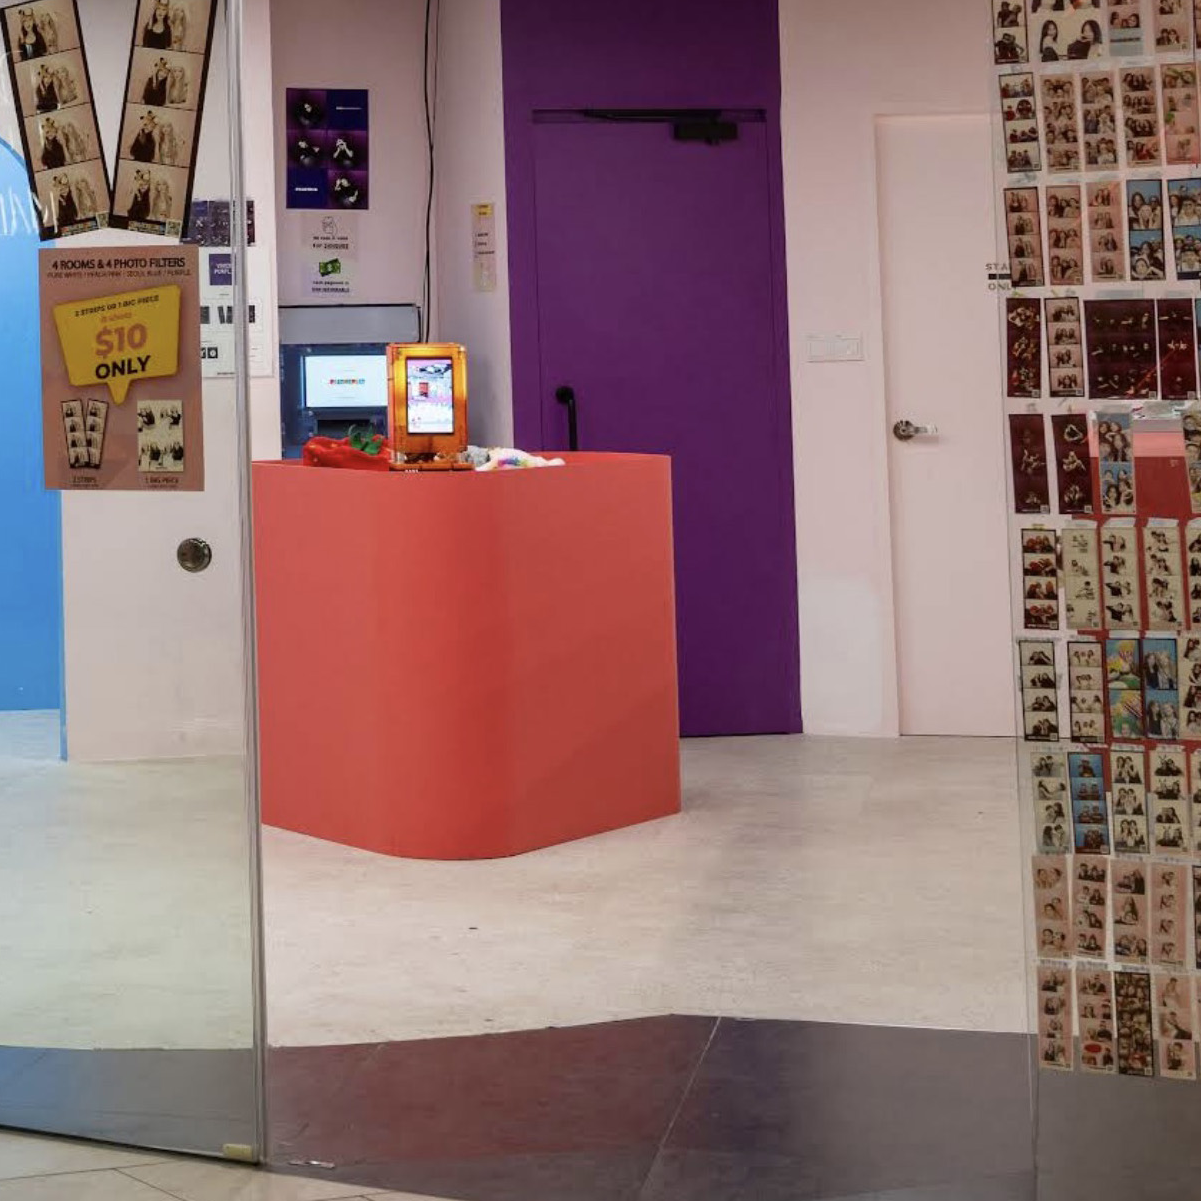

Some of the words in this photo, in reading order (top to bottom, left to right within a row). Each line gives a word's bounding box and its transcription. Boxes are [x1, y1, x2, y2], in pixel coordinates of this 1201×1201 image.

[52, 260, 58, 270] 4
[60, 259, 95, 270] ROOMS
[97, 259, 104, 268] &
[106, 259, 112, 268] 4
[114, 258, 147, 268] PHOTO
[149, 257, 186, 268] FILTERS
[95, 322, 147, 359] $10
[95, 354, 151, 379] ONLY
